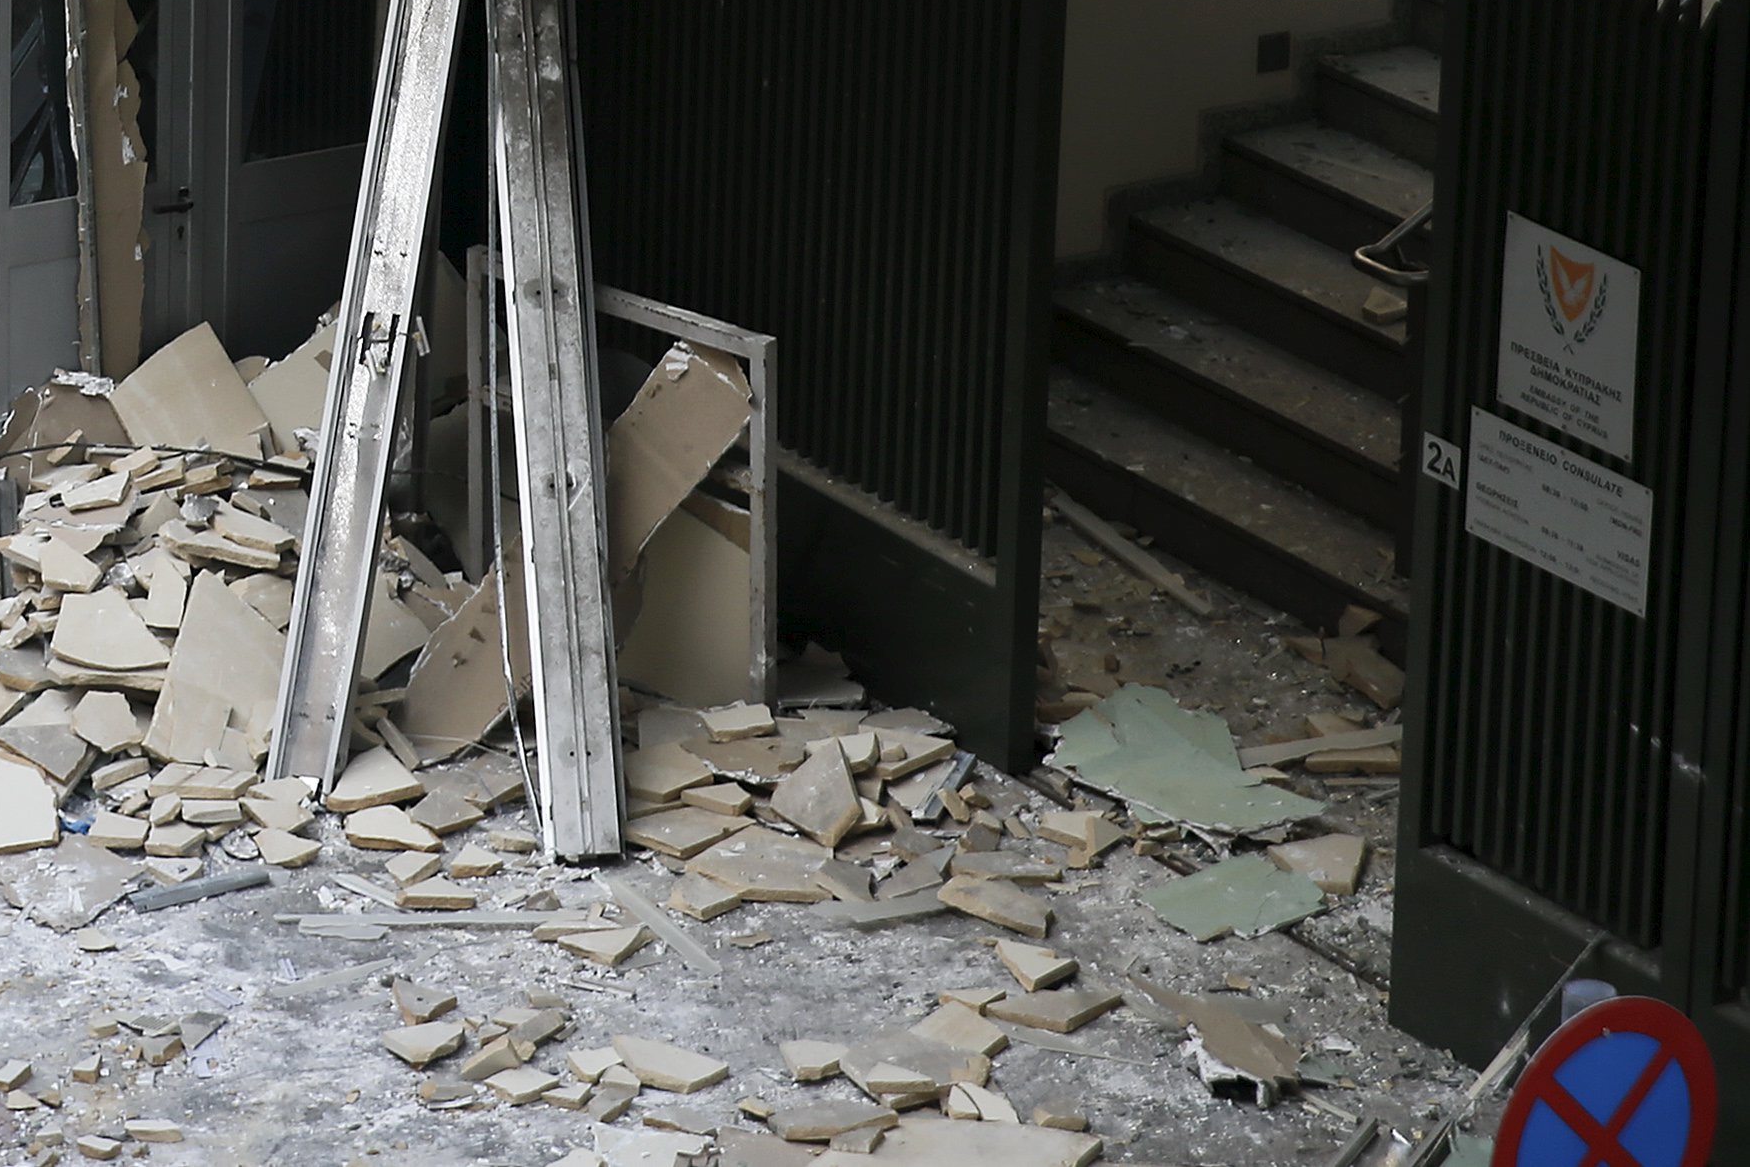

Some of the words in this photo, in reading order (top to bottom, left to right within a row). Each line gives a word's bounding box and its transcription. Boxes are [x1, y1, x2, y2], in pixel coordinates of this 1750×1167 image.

[1510, 340, 1561, 373] ΠΡΕΣΒΕΙΑ
[1564, 366, 1623, 404] ΚΥΠΡΙΑΚΗΣ
[1529, 364, 1602, 407] ΔΗΜΟΚΡΑΤΙΑΣ
[1520, 391, 1560, 415] REPUBLIC
[1561, 411, 1573, 421] OF
[1576, 418, 1609, 439] CYPRUS
[1529, 384, 1567, 406] EMBASSY
[1570, 403, 1581, 413] OF
[1584, 409, 1600, 424] THE
[1427, 442, 1457, 481] 2A
[1498, 429, 1558, 465] ΠΡΟΞΕΝΕΙΟ
[1561, 459, 1625, 498] CONSULATE
